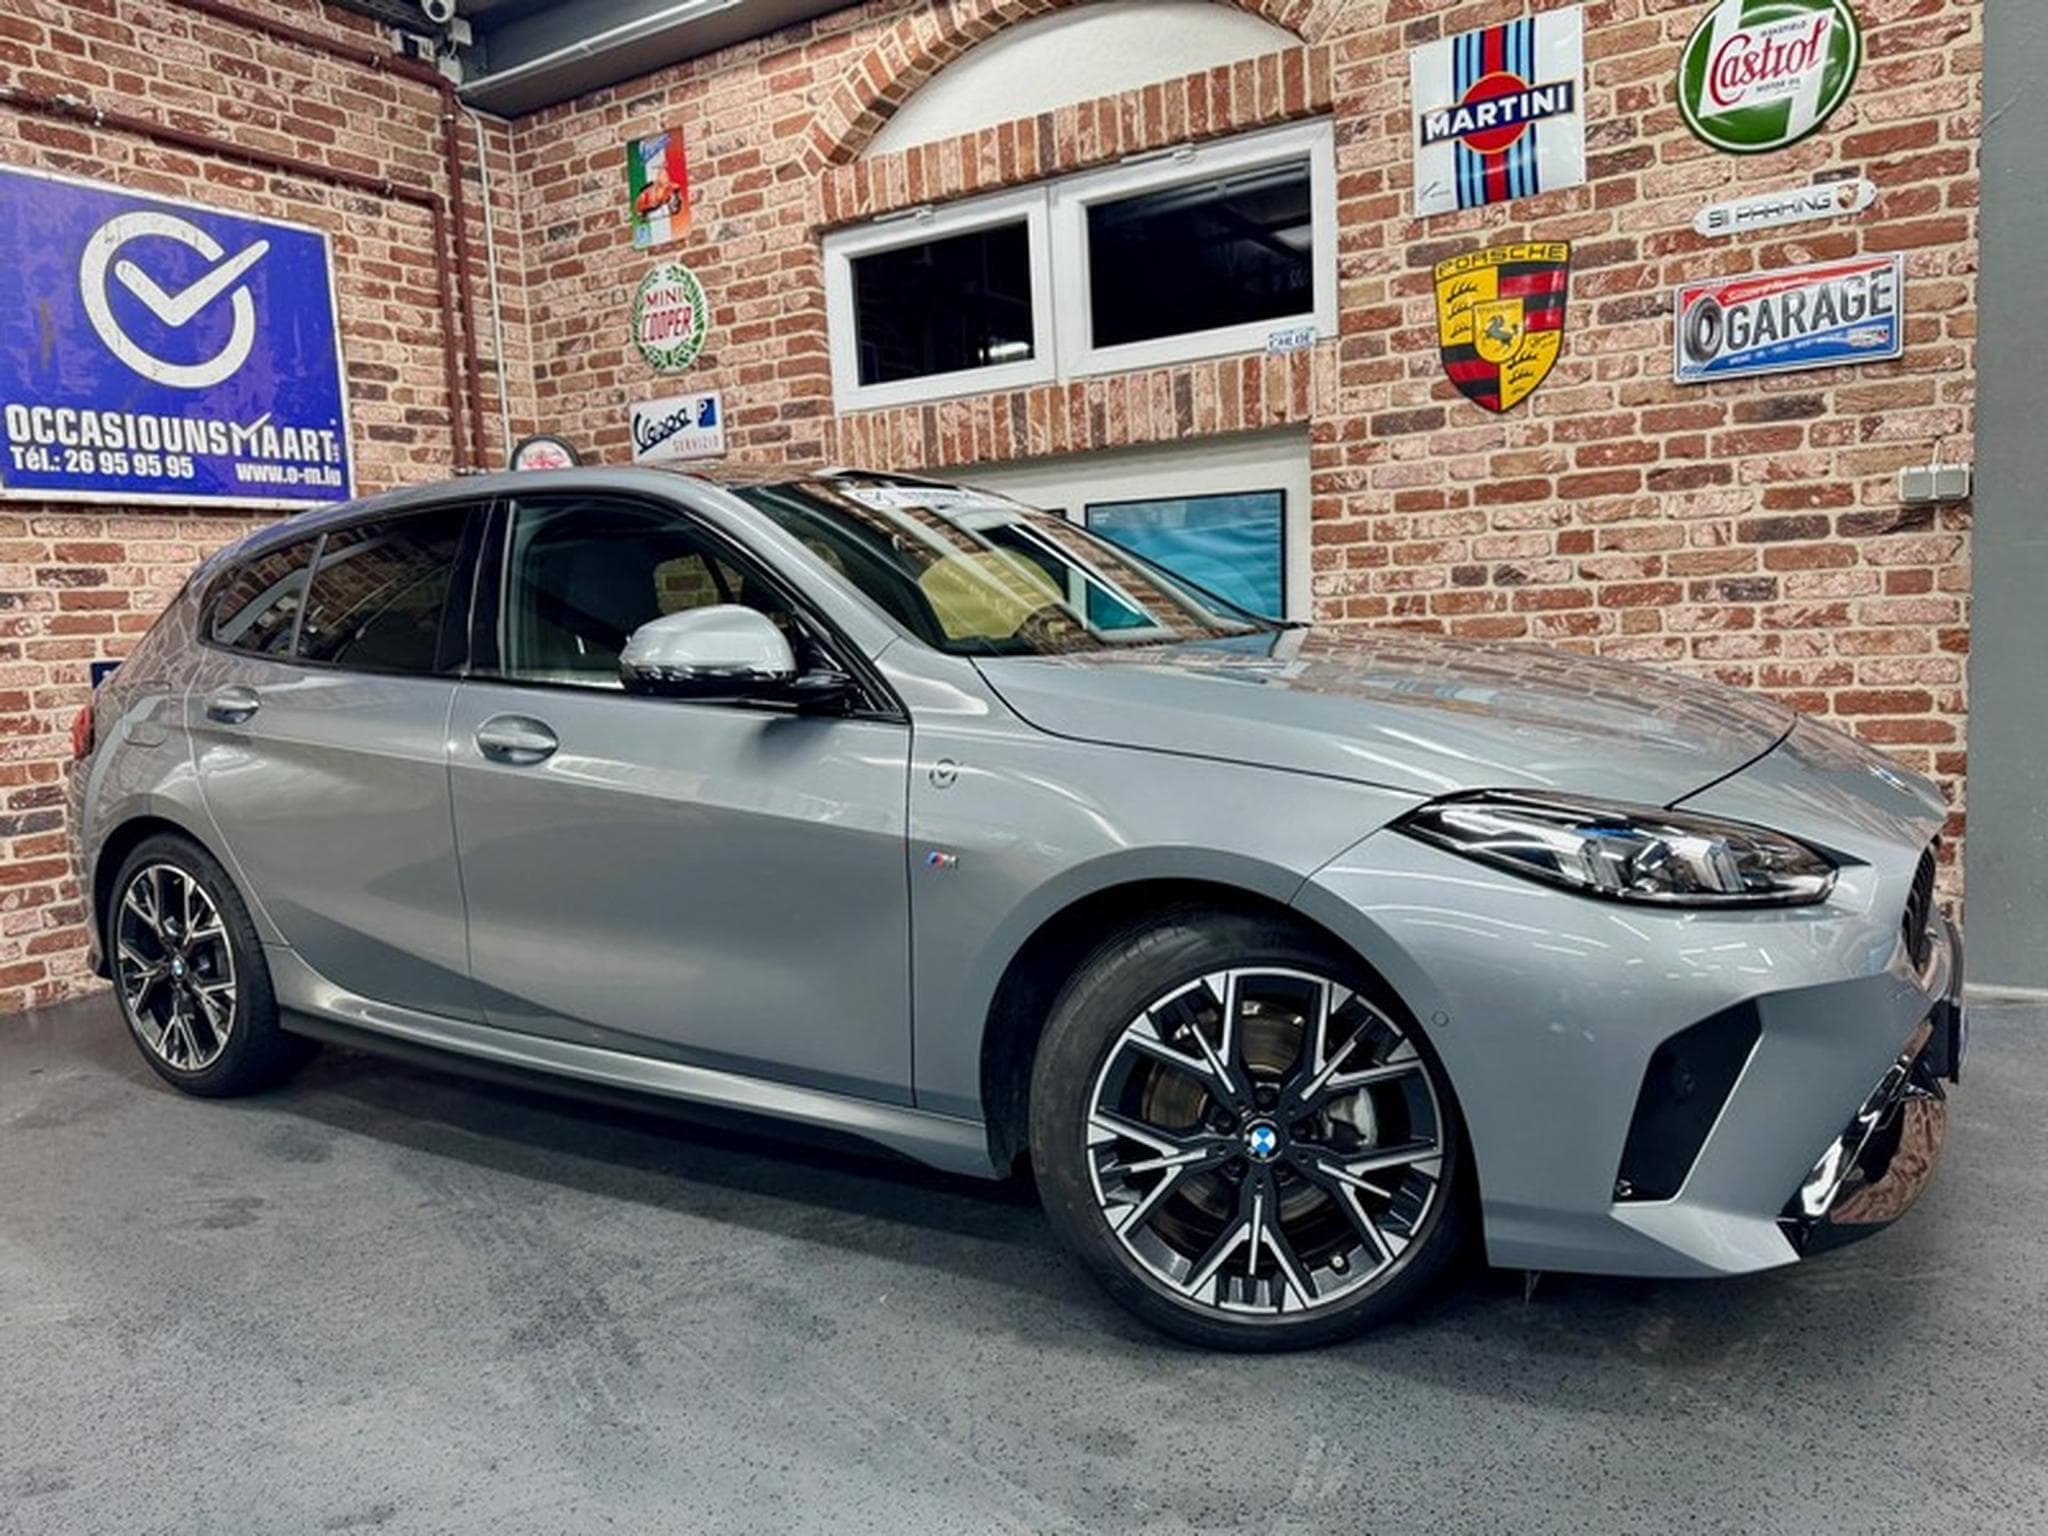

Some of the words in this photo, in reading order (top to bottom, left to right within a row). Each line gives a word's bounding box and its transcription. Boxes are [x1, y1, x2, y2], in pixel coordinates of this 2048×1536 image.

[1709, 16, 1829, 107] Castrol
[1426, 85, 1567, 141] MARTINI
[1735, 191, 1832, 223] PARKING
[1438, 244, 1565, 278] PORSCHE
[645, 287, 685, 307] MINI
[1726, 266, 1893, 351] GARAGE
[641, 305, 693, 343] COOPER
[633, 411, 693, 456] Vespa
[64, 448, 96, 474] 26
[99, 450, 130, 476] 95
[132, 452, 163, 478] 95
[165, 454, 195, 480] 95
